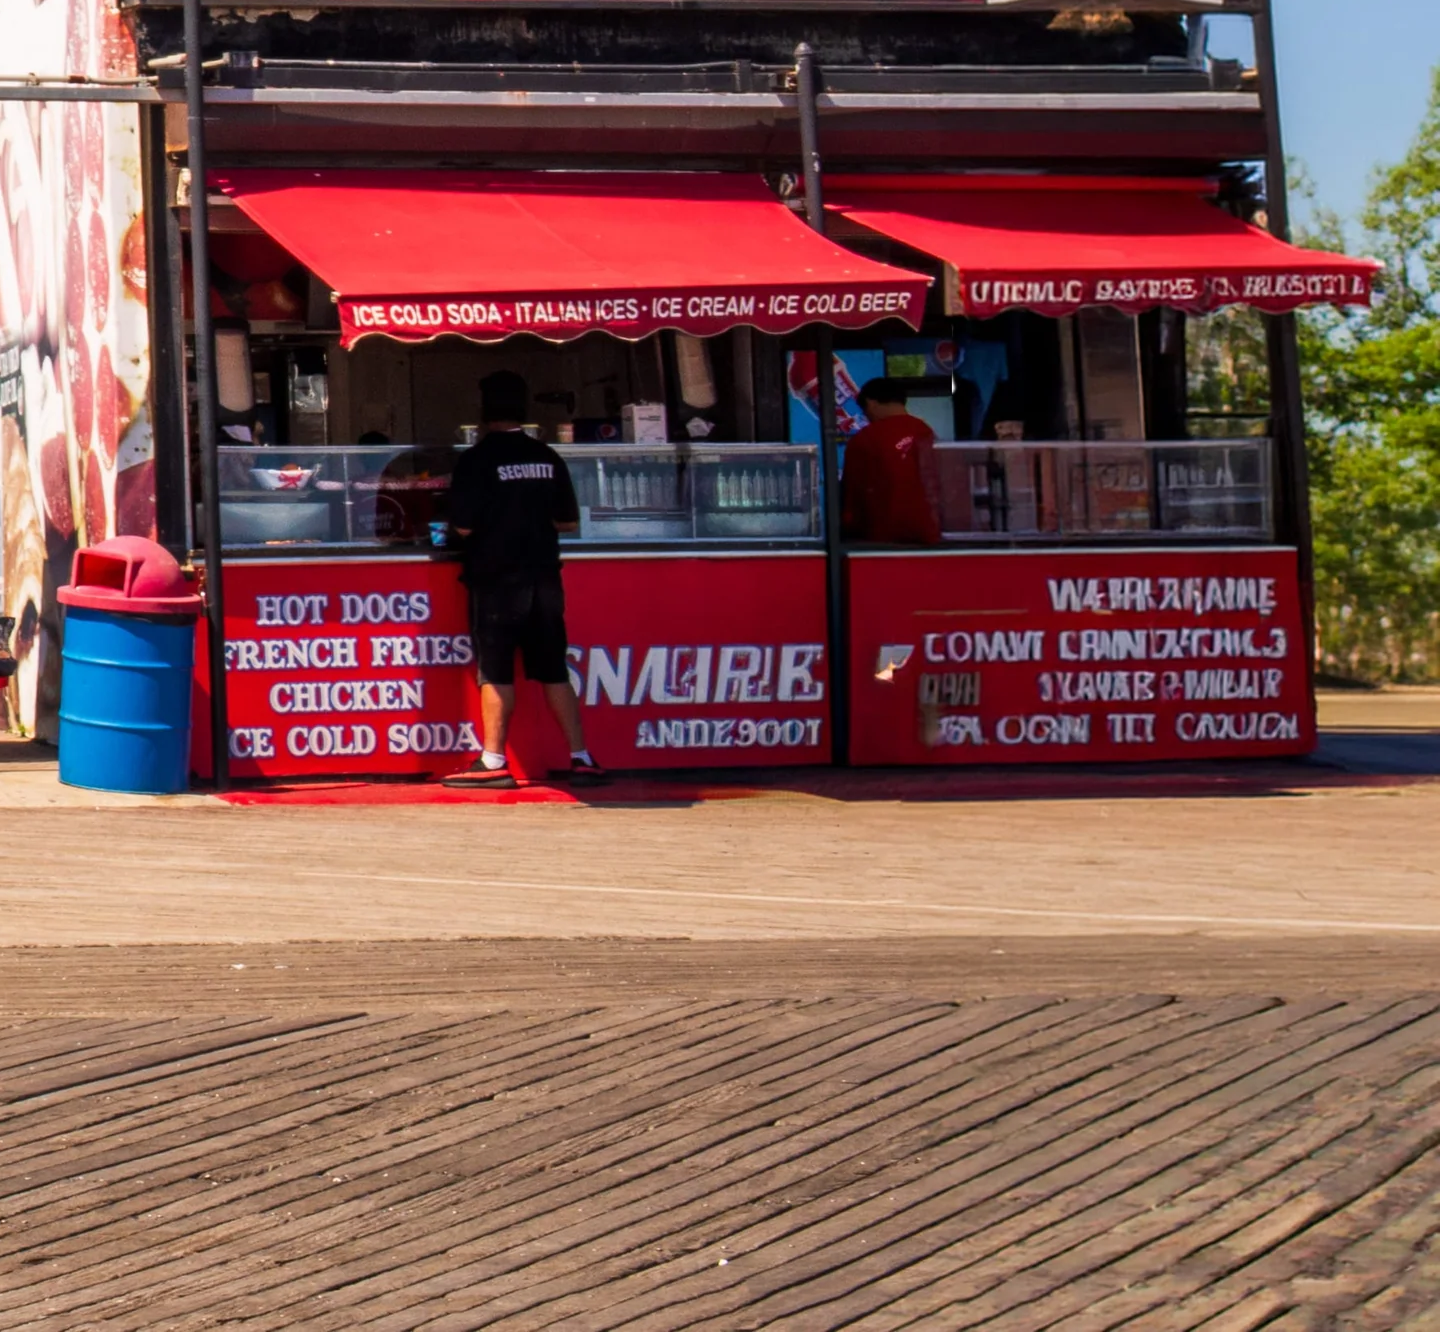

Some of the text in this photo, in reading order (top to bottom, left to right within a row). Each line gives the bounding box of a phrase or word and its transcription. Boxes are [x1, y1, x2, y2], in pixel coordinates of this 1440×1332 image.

[353, 292, 912, 327] ICE COLD SODA ITALIAN ICES ICE CREAM ICE COLD BEER
[498, 464, 554, 482] SECURITY
[257, 592, 430, 627] HOT DOGS
[224, 636, 474, 670] FRENCH FRIES
[269, 680, 425, 713] CHICKEN
[287, 725, 378, 757] COLD
[388, 722, 483, 755] SODA
